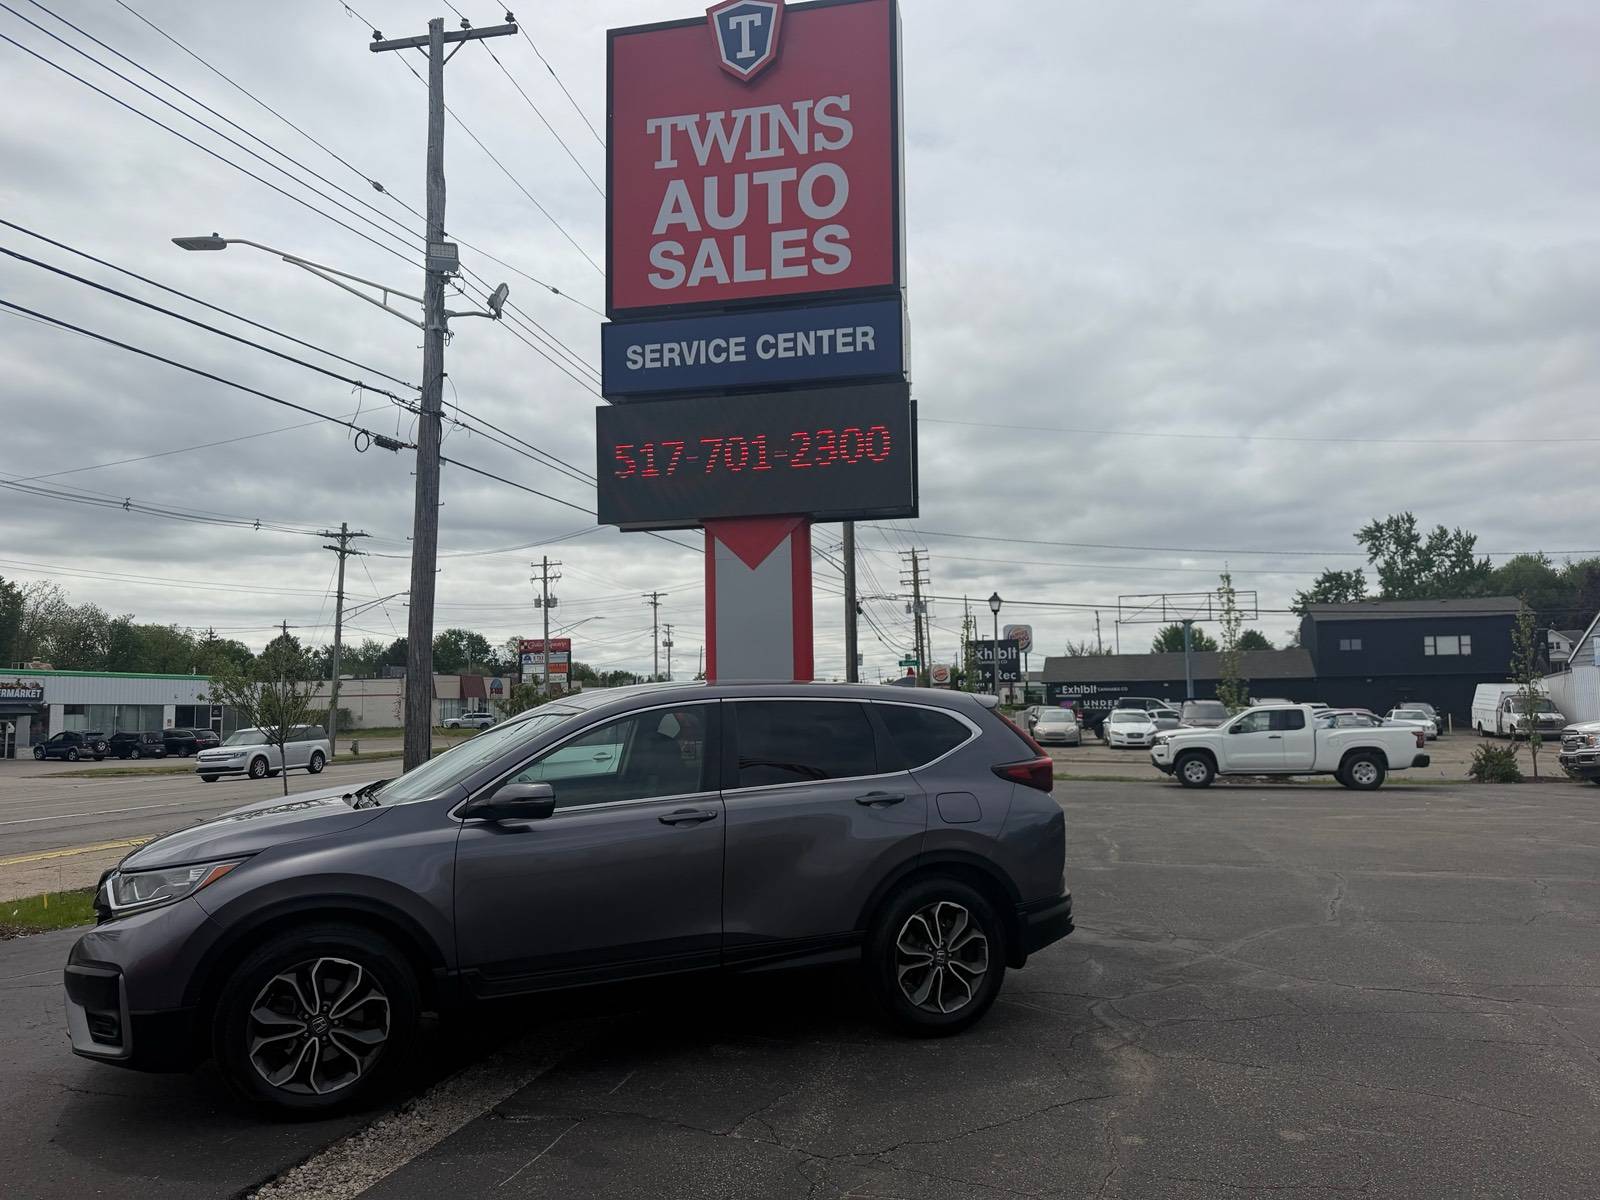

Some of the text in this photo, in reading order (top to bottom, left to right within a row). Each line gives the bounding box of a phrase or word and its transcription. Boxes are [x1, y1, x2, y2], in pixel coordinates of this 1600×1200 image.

[729, 13, 762, 59] T
[646, 94, 854, 169] TWINS
[652, 162, 849, 235] AUTO
[648, 224, 852, 290] SALES
[626, 326, 875, 370] SERVICE CENTER
[614, 426, 891, 479] 517-701-2300
[1062, 684, 1097, 694] Exhibit
